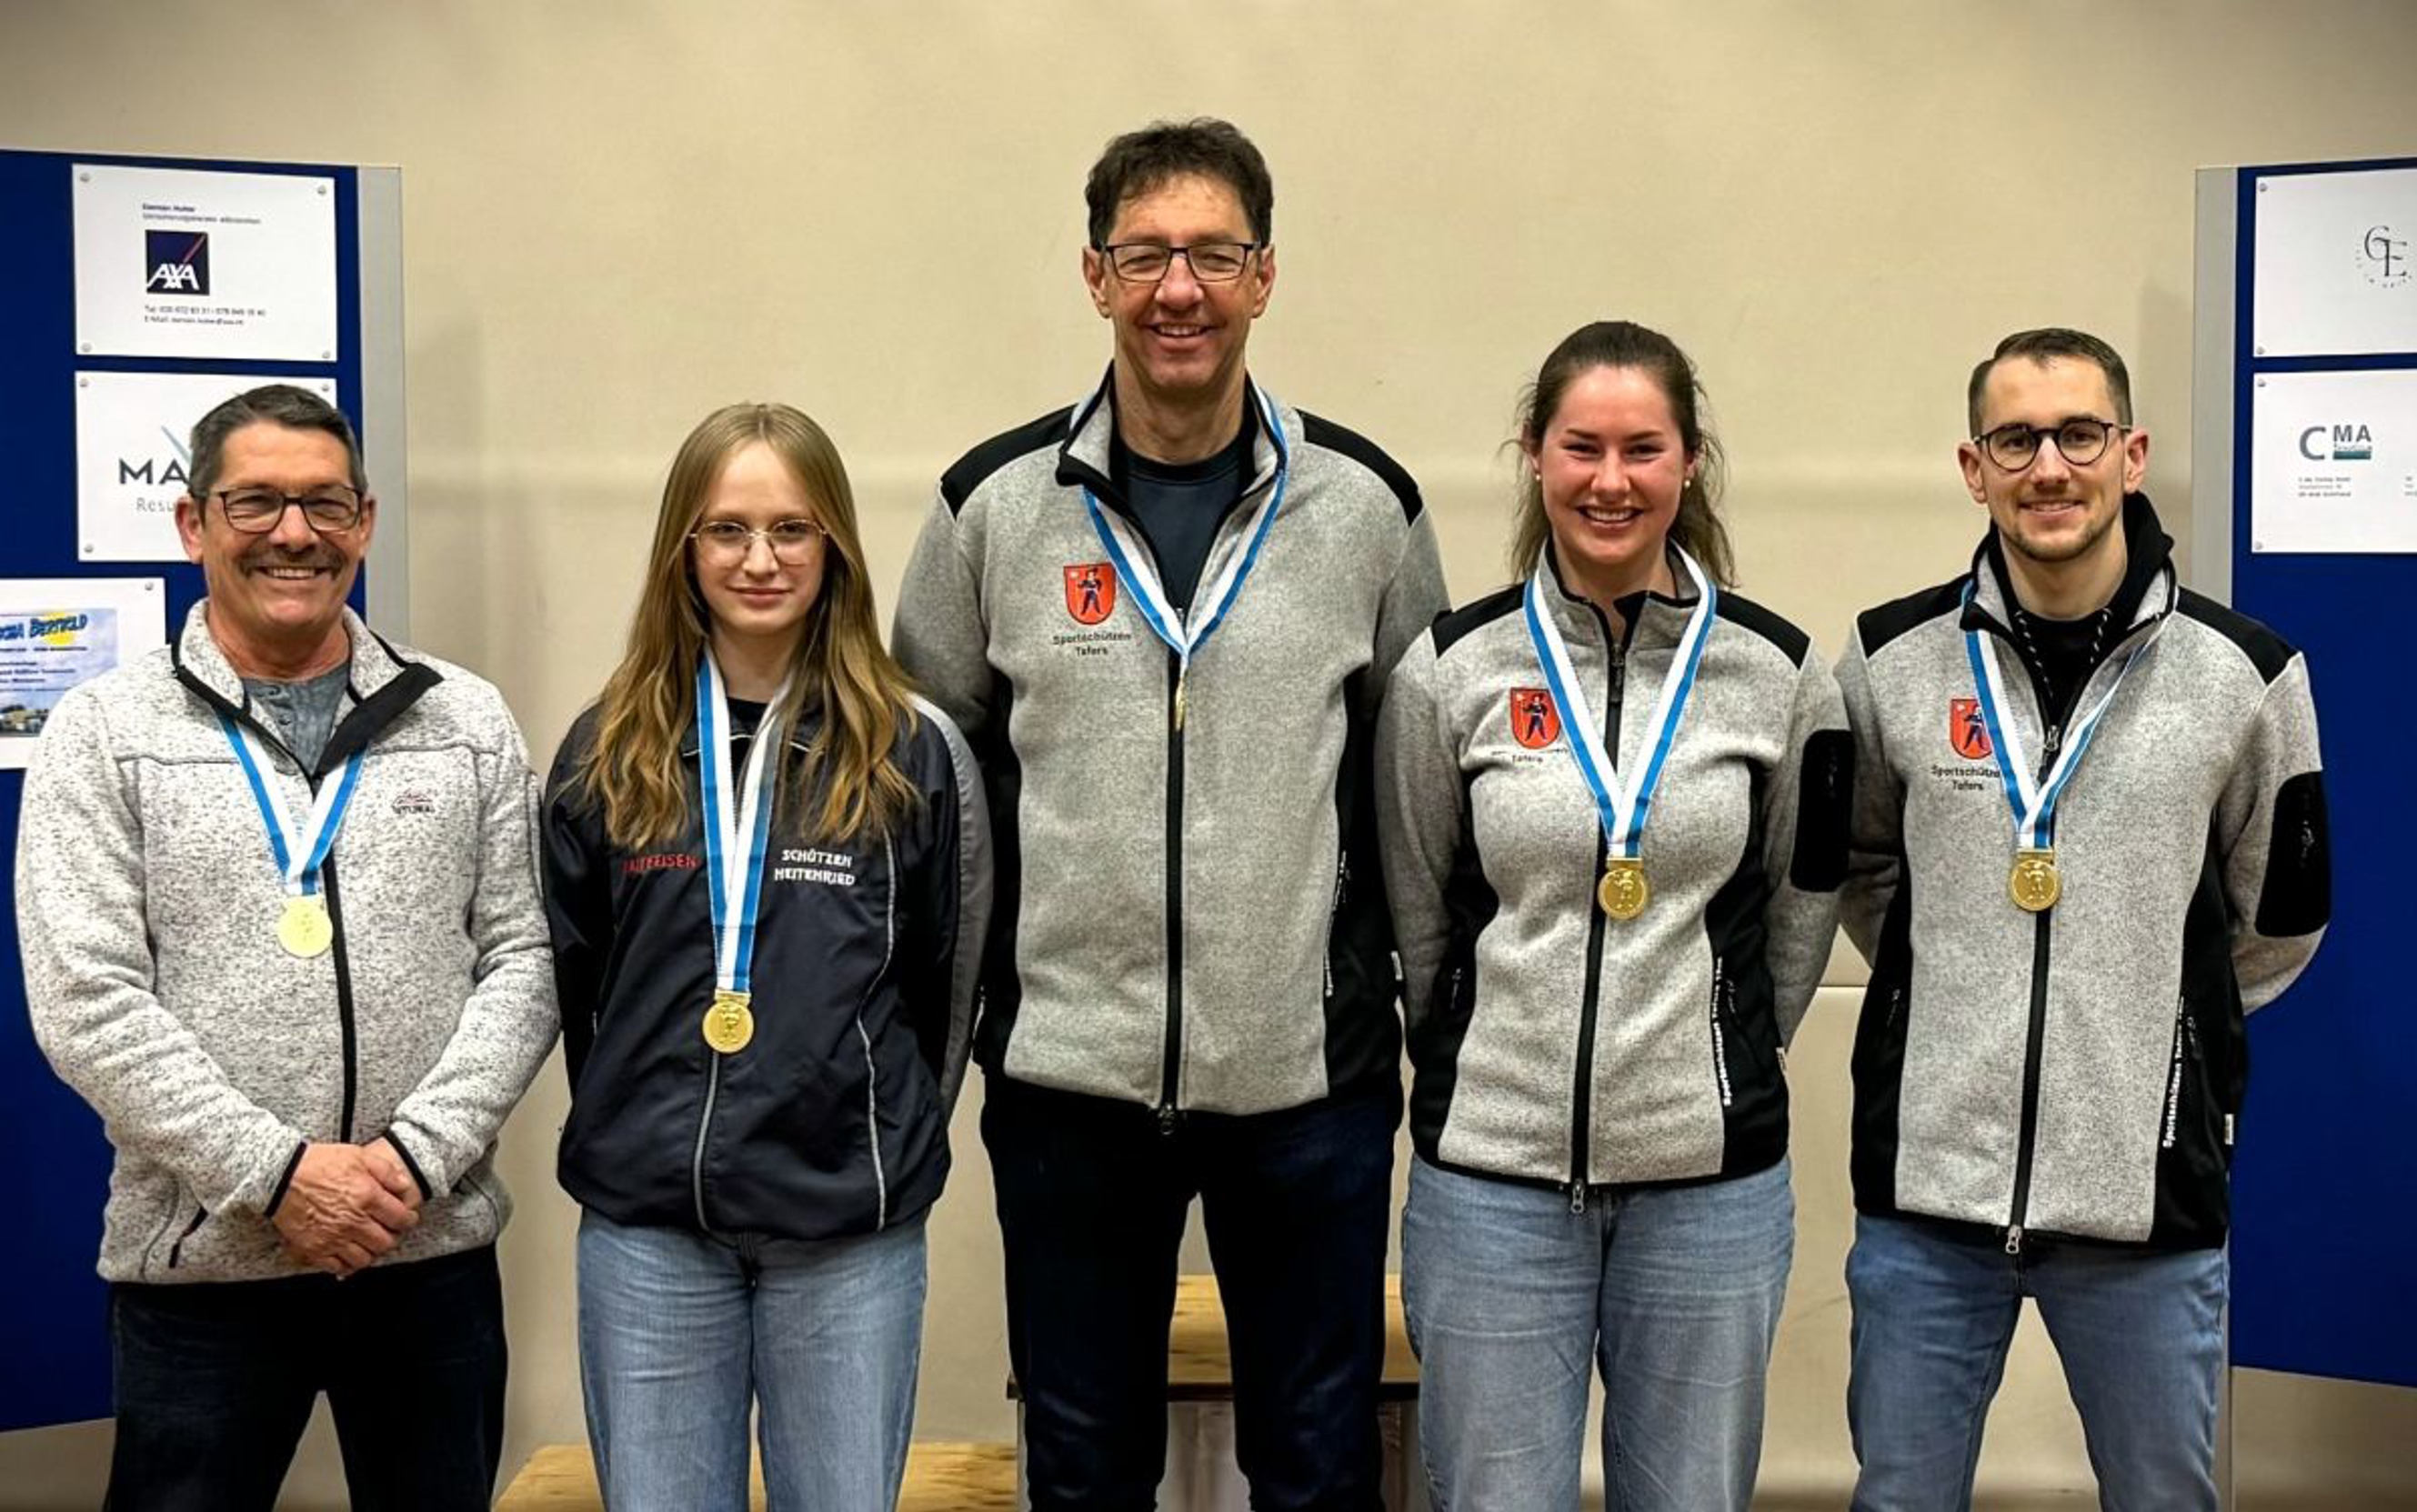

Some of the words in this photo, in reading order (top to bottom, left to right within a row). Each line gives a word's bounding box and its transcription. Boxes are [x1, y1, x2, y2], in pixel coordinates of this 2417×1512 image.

[147, 264, 199, 290] AXA
[781, 847, 853, 869] SCHÜTZEN
[774, 867, 856, 886] HEITENRIED
